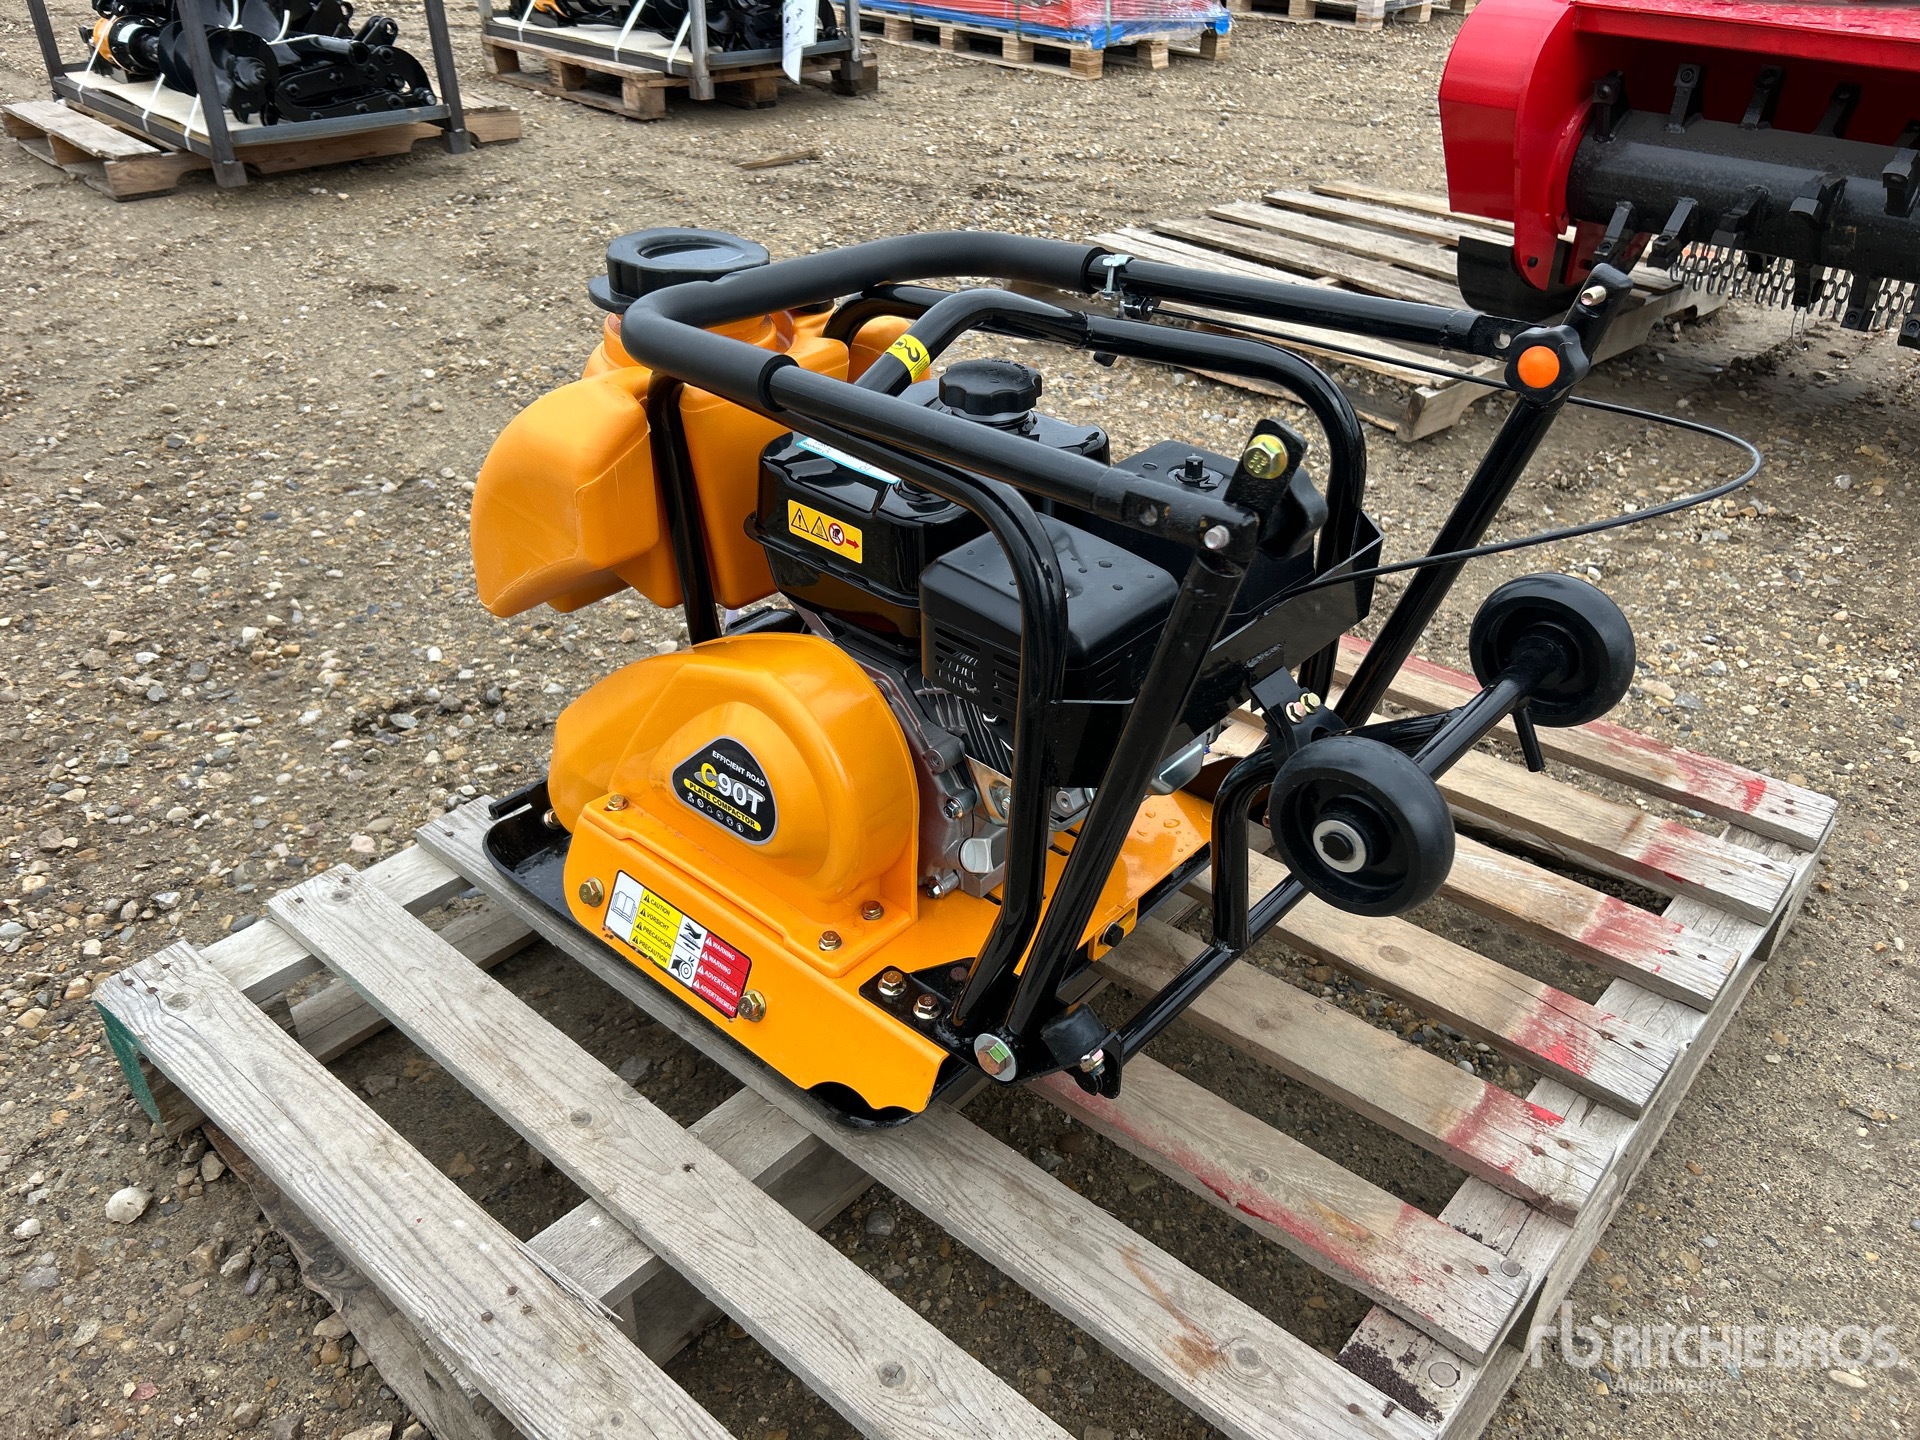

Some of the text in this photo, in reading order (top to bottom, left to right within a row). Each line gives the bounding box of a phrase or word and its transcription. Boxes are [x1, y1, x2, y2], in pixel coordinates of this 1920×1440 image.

[712, 750, 766, 787] EFFICIENT ROAD
[700, 762, 764, 815] C90T
[689, 782, 756, 827] PLATE COMPACTOR
[650, 899, 671, 916] CAUTION
[646, 911, 670, 931] VORSICHT
[638, 937, 668, 963] PRECAUTION
[642, 924, 672, 950] PRECAUCION
[712, 942, 736, 961] WARNING
[708, 956, 732, 975] WARNING
[704, 970, 738, 998] ADVERTENCIA
